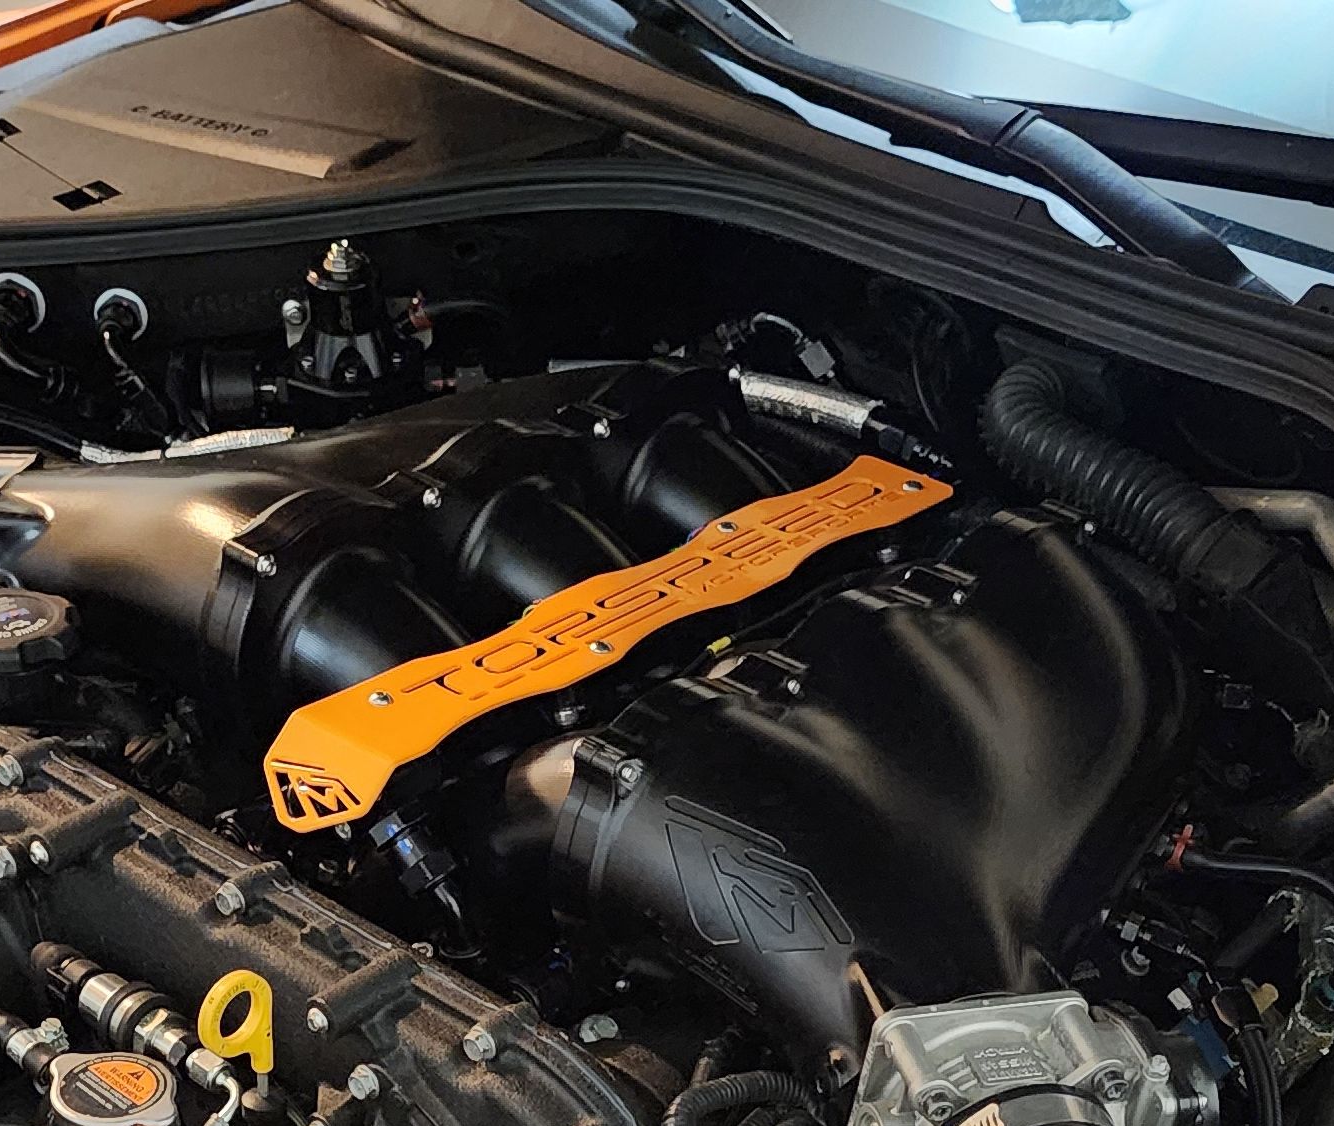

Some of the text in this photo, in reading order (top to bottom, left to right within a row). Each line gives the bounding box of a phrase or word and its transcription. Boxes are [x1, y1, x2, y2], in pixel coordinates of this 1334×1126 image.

[151, 108, 252, 134] BATTERY
[400, 476, 885, 696] TOPSPEED
[109, 1066, 145, 1093] WARNING
